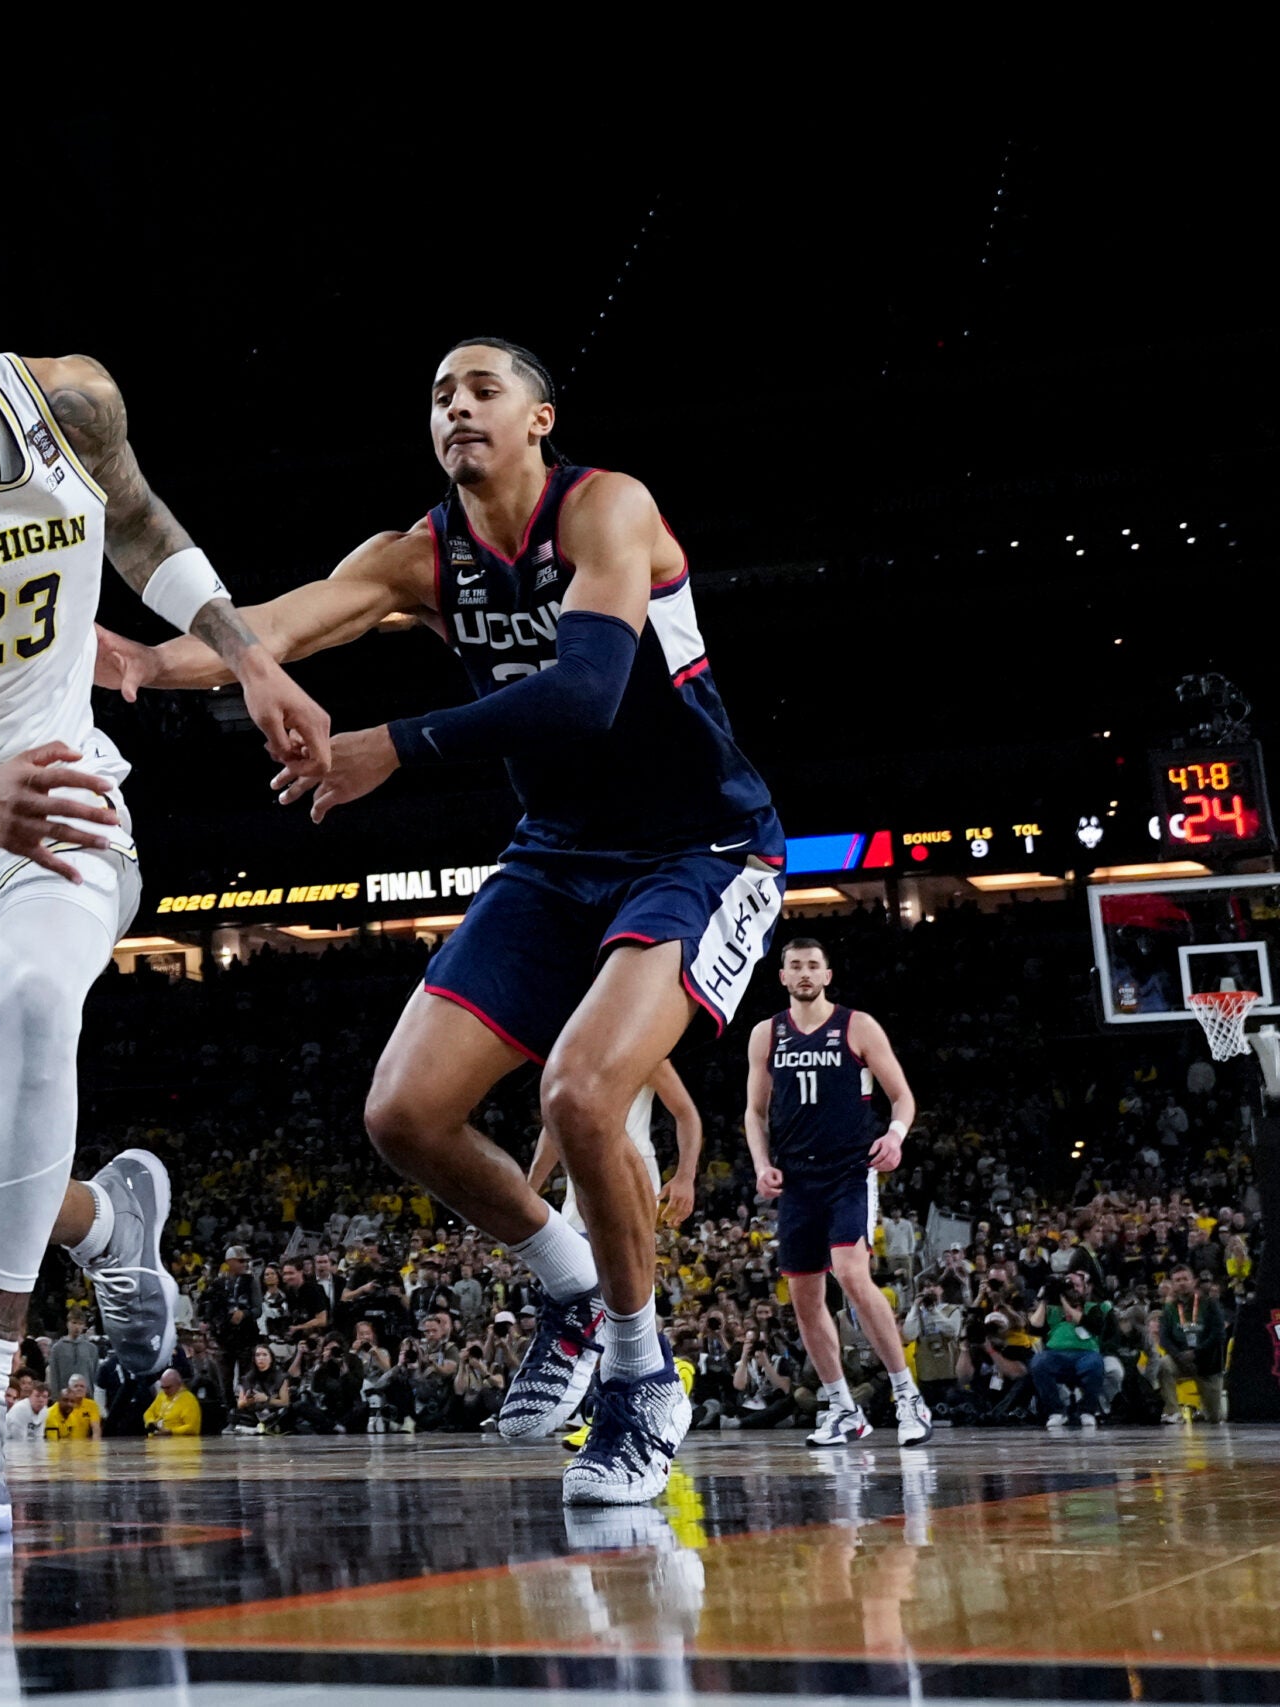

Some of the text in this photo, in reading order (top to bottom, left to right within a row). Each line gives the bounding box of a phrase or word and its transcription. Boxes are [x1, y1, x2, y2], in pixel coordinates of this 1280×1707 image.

[1168, 762, 1230, 791] 47.8
[1183, 795, 1244, 844] 24
[903, 824, 1042, 845] BONUS FLS TOL
[971, 836, 1034, 858] 9 1
[157, 894, 216, 913] 2026
[218, 889, 283, 909] NCAA
[286, 883, 360, 904] MEN'S
[366, 870, 437, 902] FINAL
[774, 1051, 841, 1068] UCONN
[796, 1071, 817, 1104] 11
